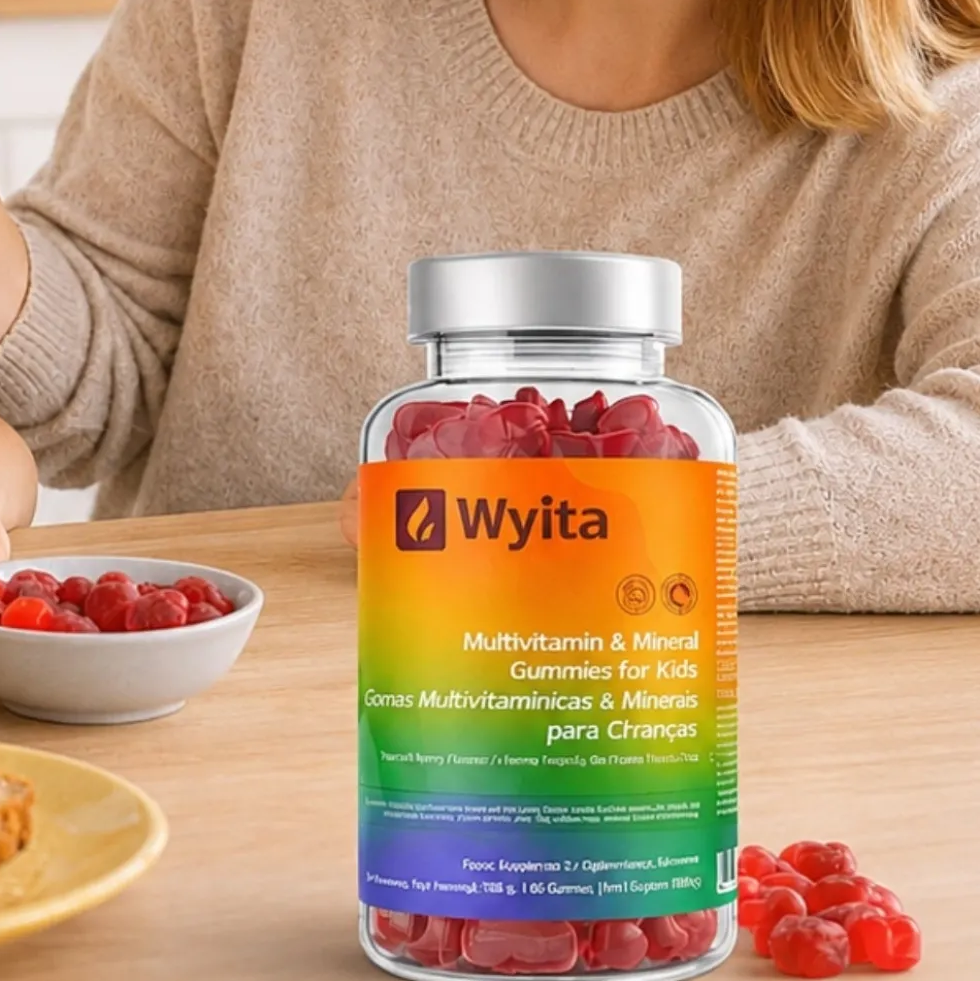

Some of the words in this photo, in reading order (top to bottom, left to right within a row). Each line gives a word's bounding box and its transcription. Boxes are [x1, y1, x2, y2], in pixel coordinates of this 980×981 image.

[456, 495, 608, 551] Wyita
[463, 632, 604, 651] Multivitamin
[610, 633, 626, 651] &
[633, 631, 699, 650] Mineral
[510, 660, 612, 680] Gummies
[619, 660, 650, 680] for
[656, 659, 698, 679] Kids
[364, 689, 414, 708] Gomas
[599, 692, 615, 710] &
[621, 690, 699, 709] Minerais
[546, 723, 600, 746] para
